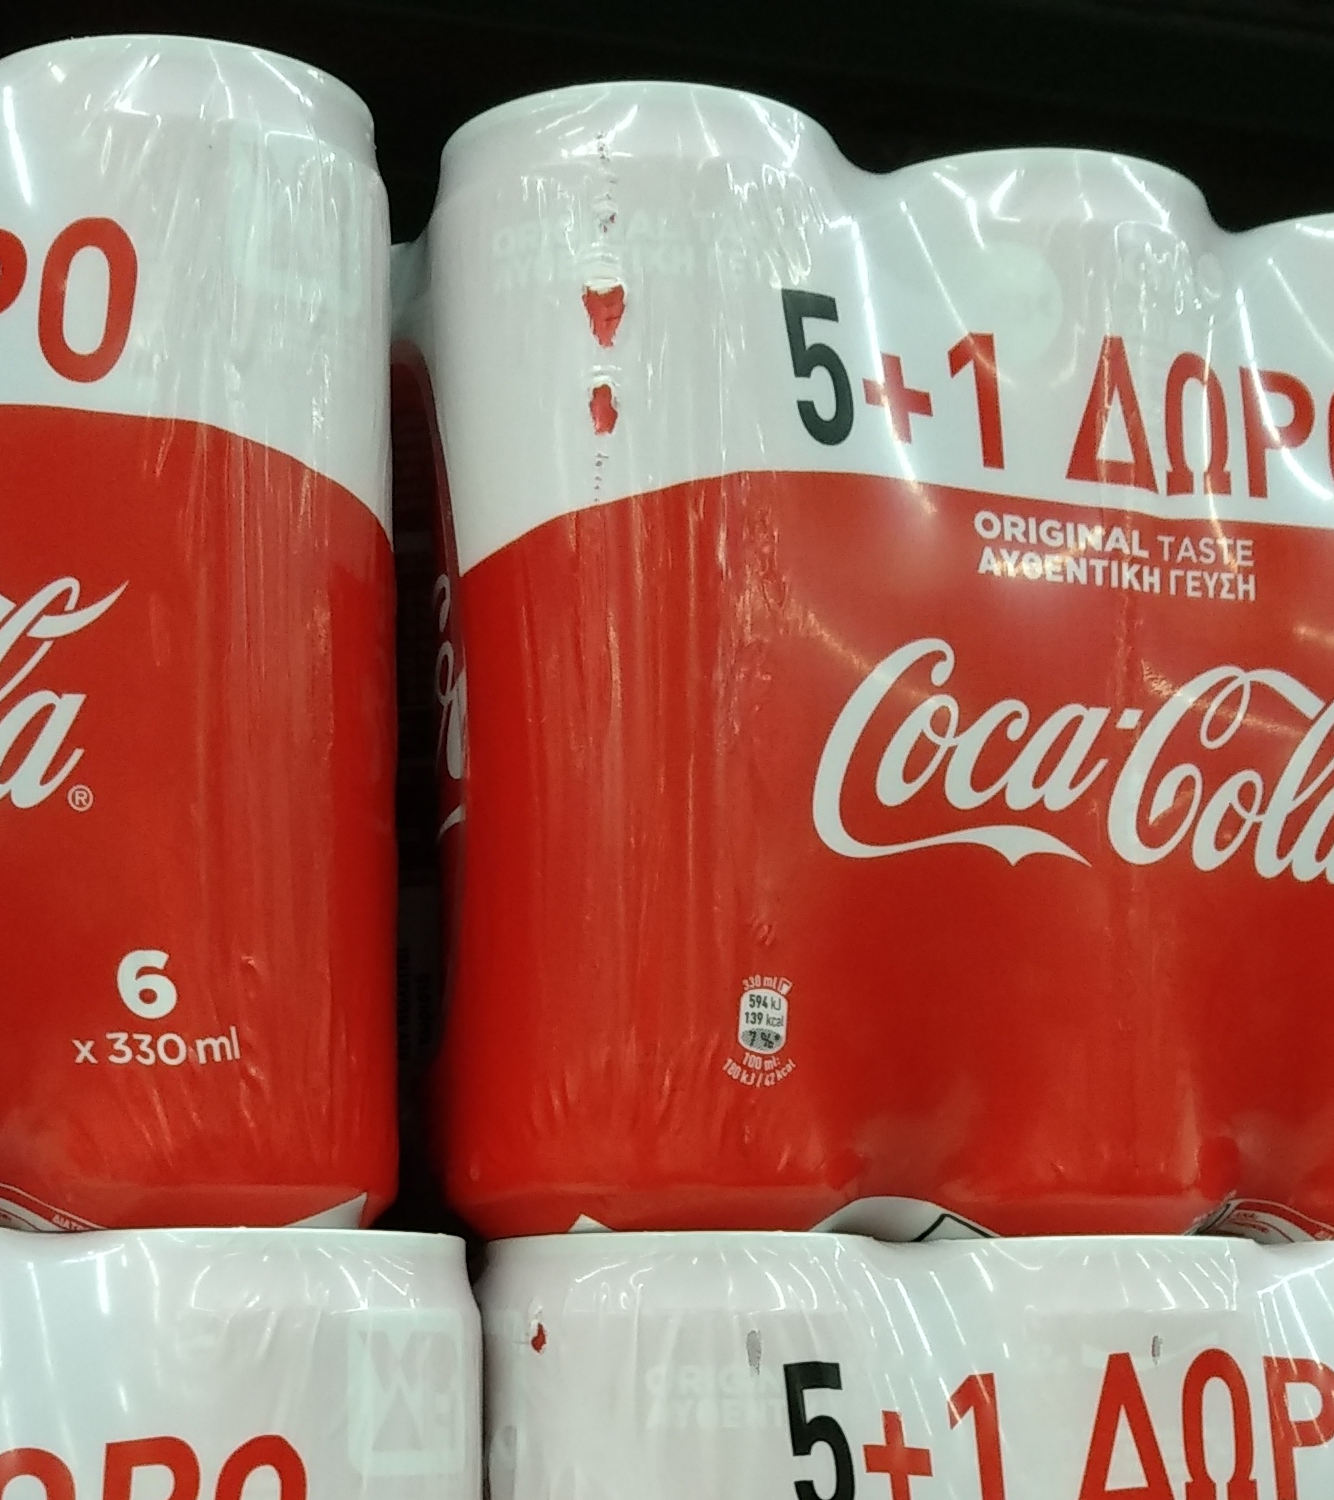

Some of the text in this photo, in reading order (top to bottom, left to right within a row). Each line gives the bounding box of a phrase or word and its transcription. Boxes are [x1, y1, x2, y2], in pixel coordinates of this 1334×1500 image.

[781, 289, 1005, 470] 5+1
[973, 511, 1255, 567] ORIGINAL TASTE
[978, 546, 1256, 601] ΑΥΘΕΝΤΙΚΗ ΓΕΥΣΗ
[117, 949, 178, 1020] 6
[749, 994, 768, 1008] 594
[744, 1012, 763, 1025] 139
